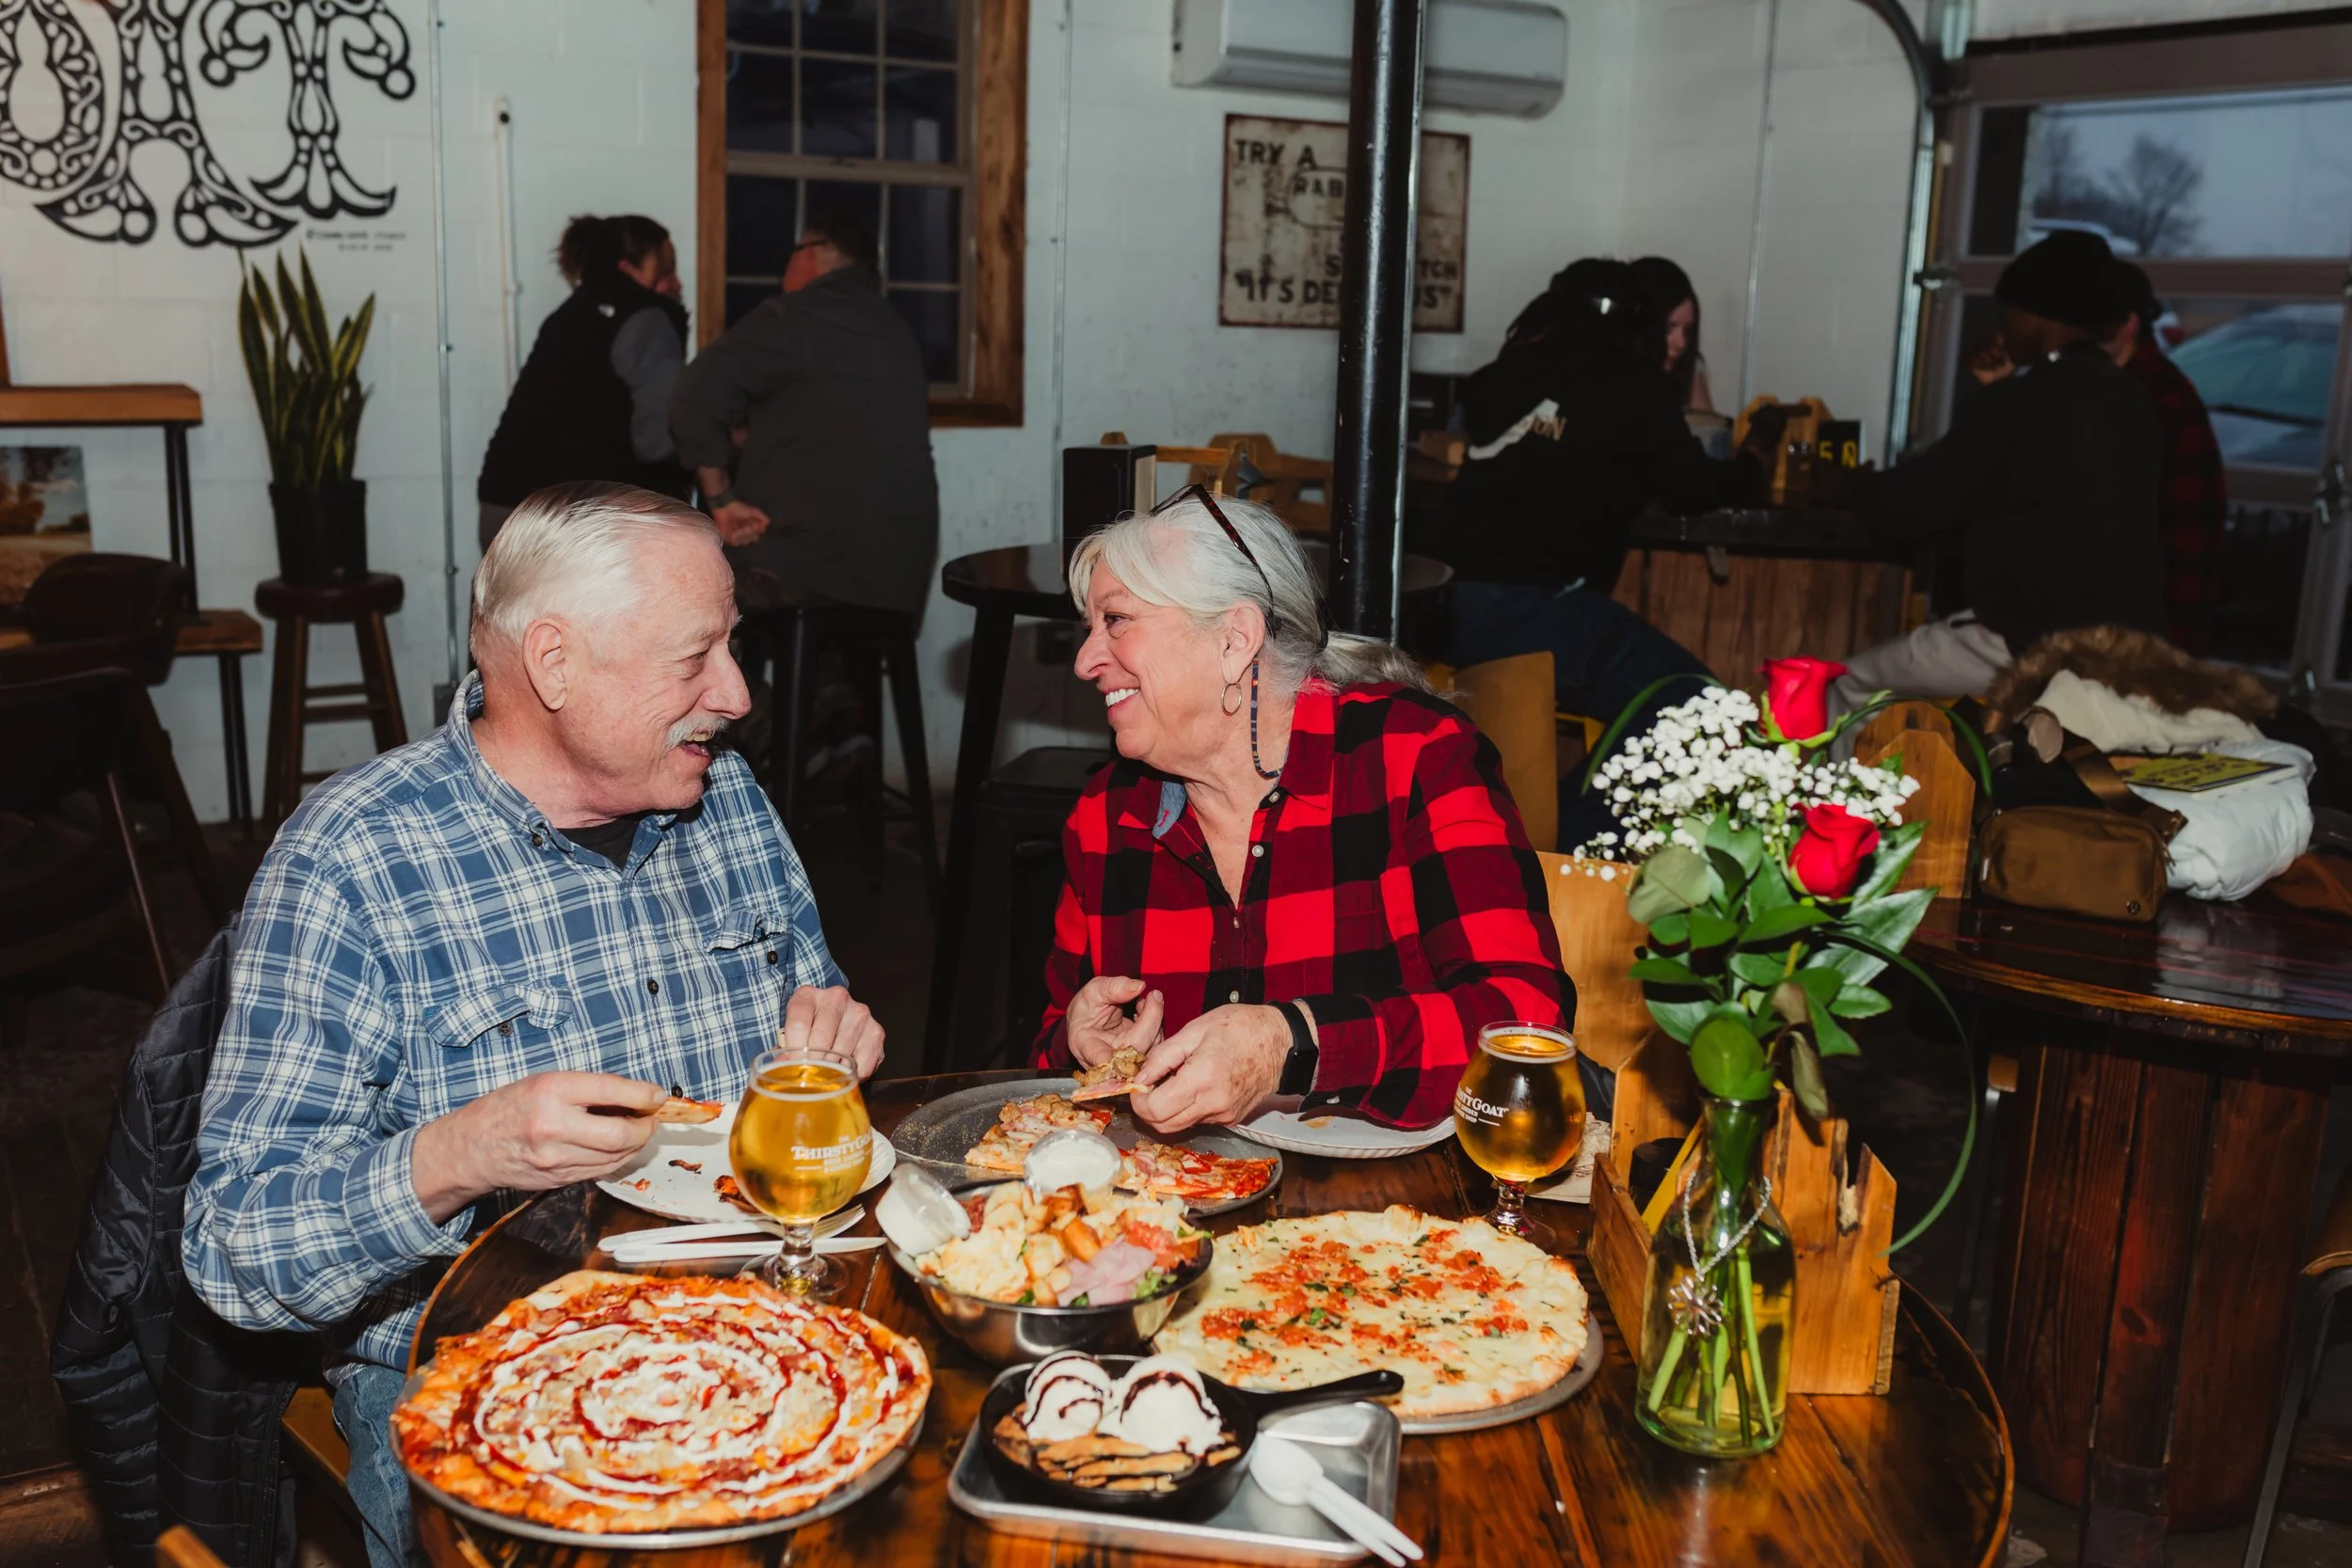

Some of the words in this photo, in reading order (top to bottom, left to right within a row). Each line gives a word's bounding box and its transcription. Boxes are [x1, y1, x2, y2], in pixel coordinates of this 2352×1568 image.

[1235, 138, 1284, 166] TRY
[1297, 145, 1317, 171] A
[1293, 176, 1344, 198] RAB
